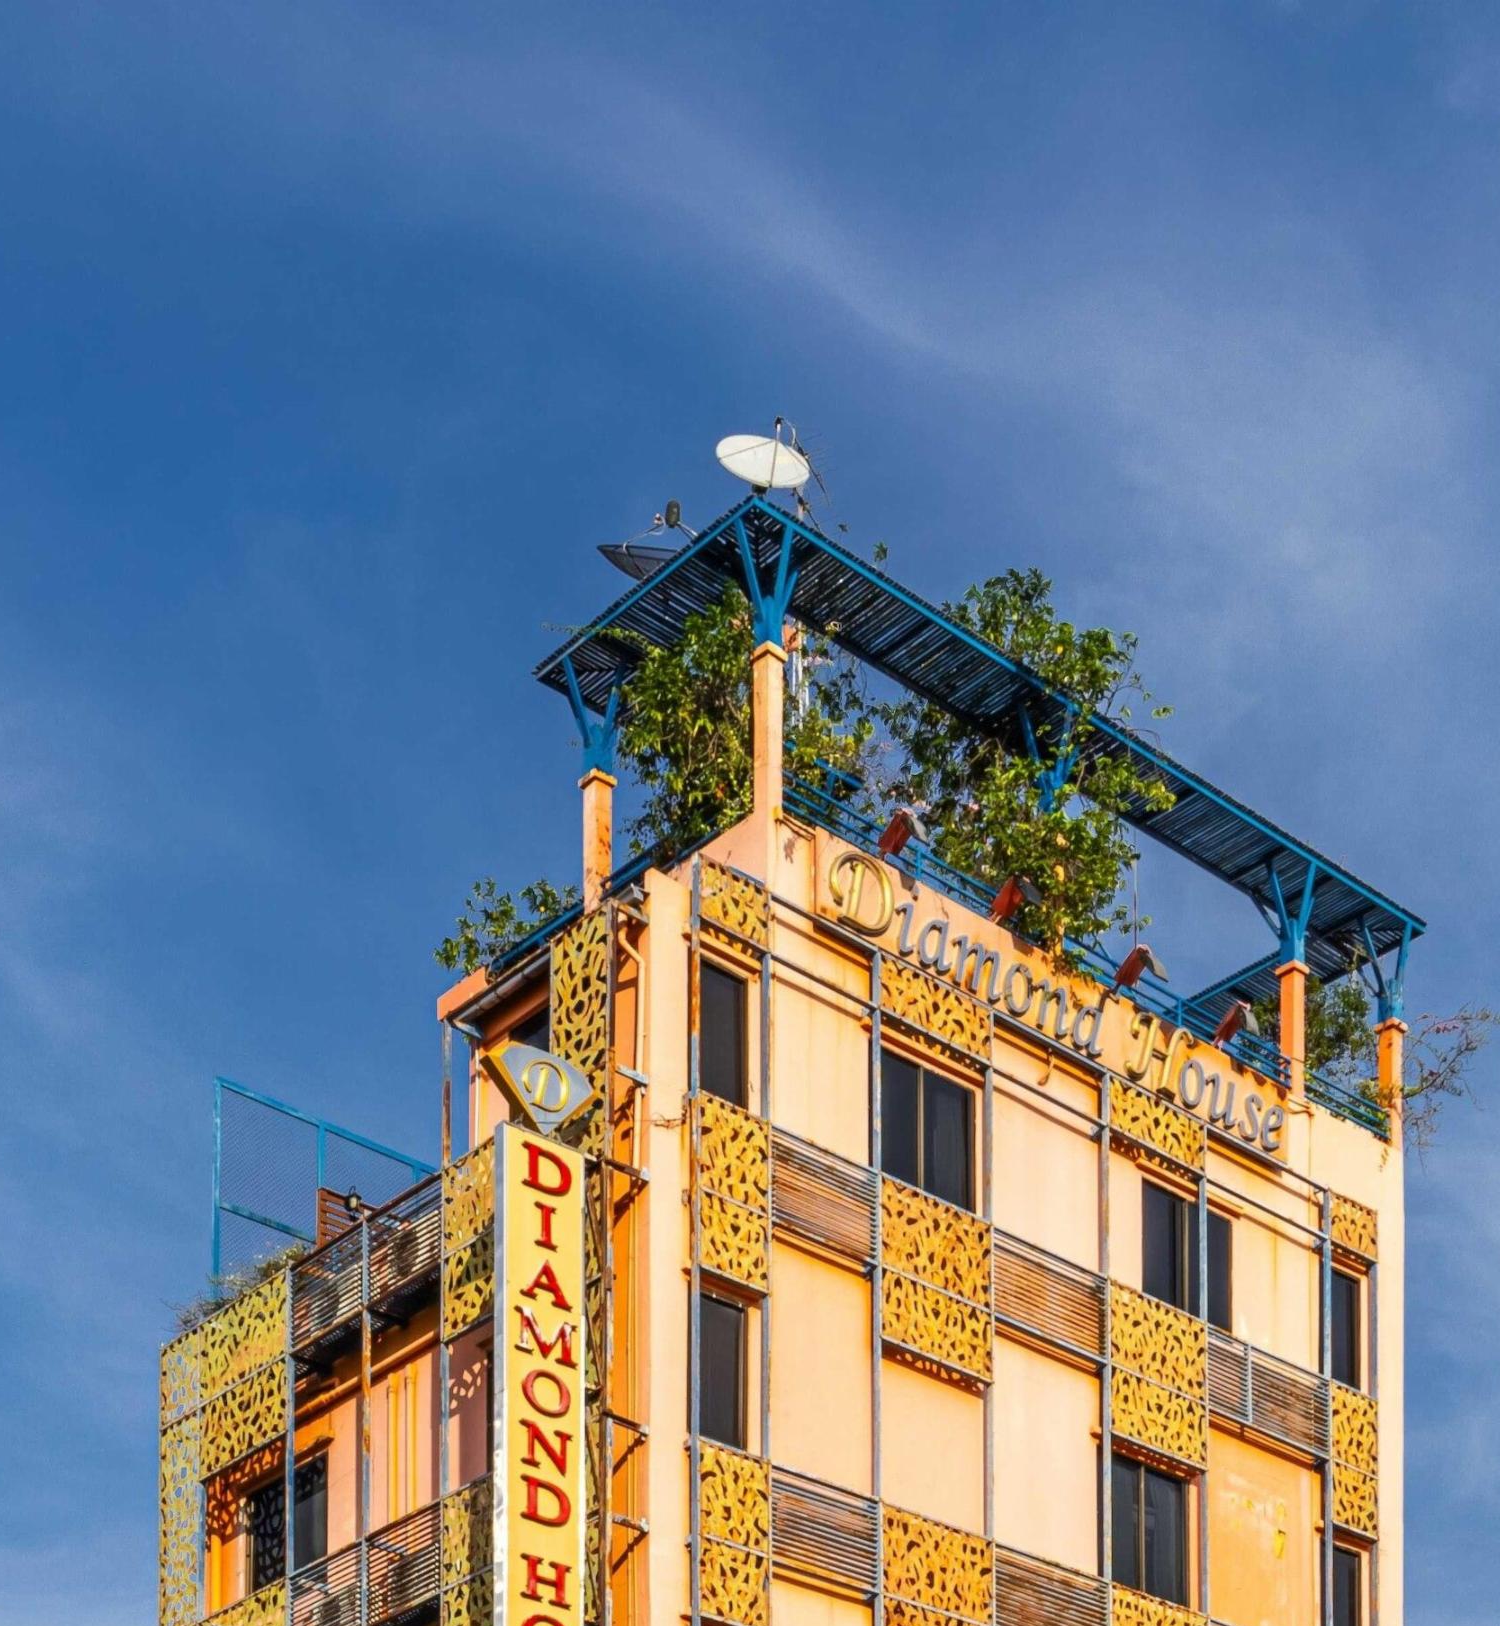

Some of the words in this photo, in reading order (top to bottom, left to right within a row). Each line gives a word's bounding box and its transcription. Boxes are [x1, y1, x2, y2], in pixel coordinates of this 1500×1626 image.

[828, 852, 1104, 1058] Diamond
[1124, 1010, 1286, 1152] House
[514, 1139, 580, 1528] DIAMOND
